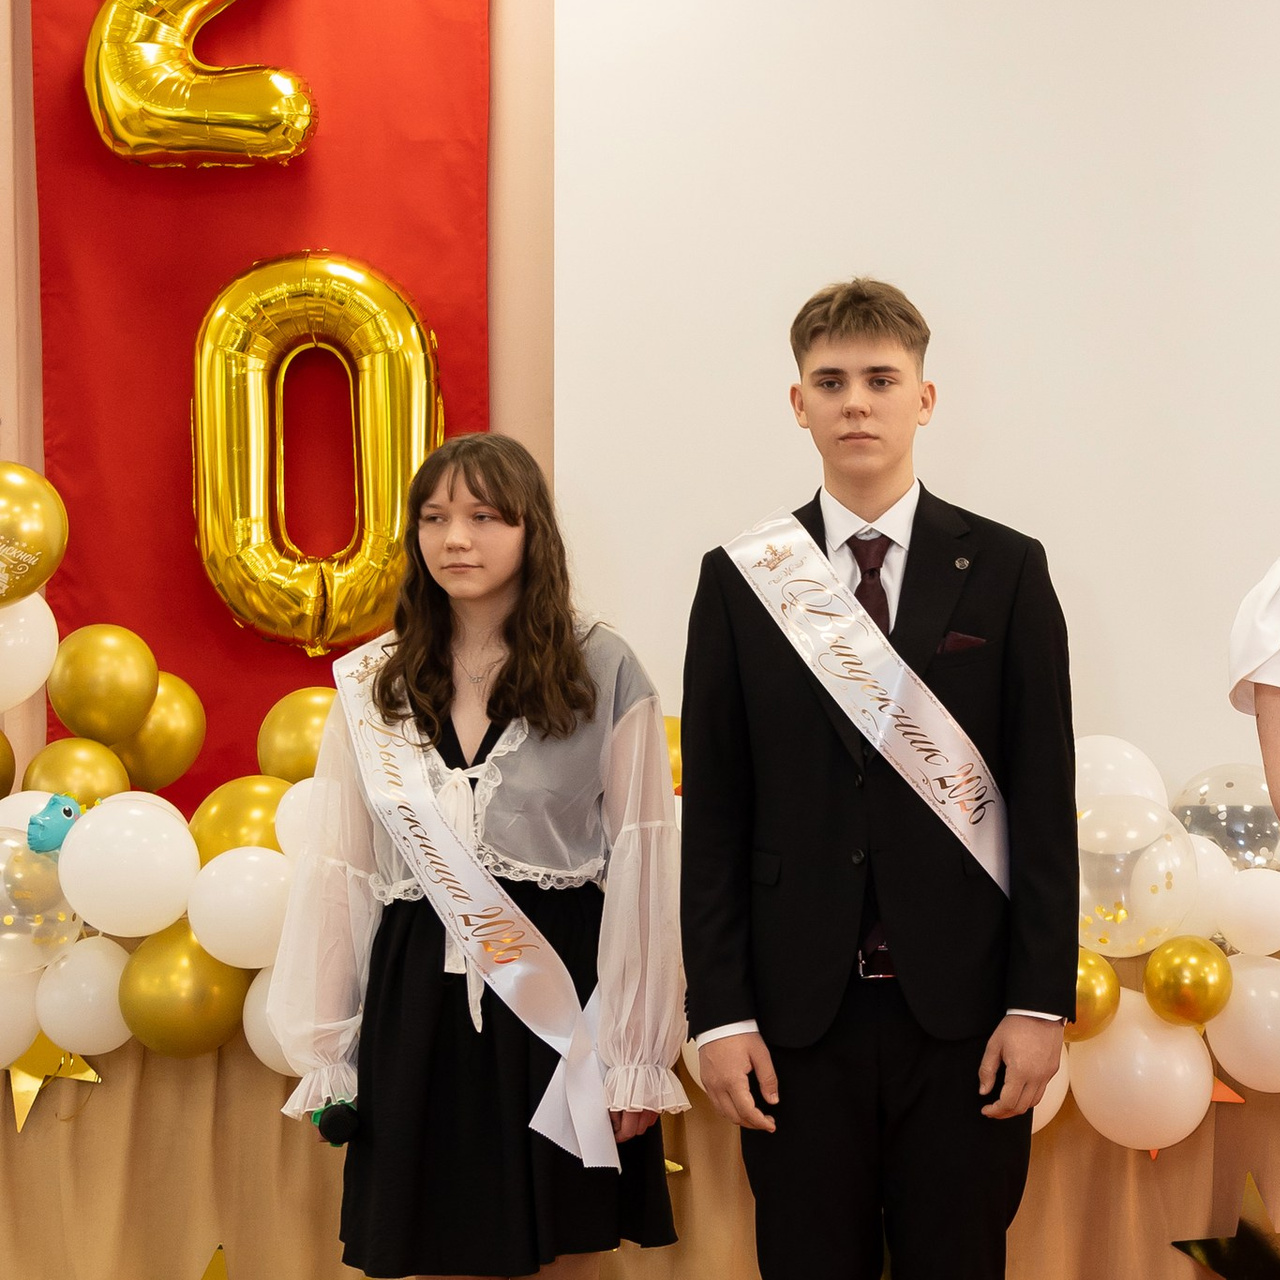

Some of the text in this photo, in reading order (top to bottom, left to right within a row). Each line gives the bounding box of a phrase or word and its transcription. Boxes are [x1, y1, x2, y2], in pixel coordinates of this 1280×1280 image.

[781, 579, 996, 826] Выпускник 2026
[458, 906, 540, 964] 2026
